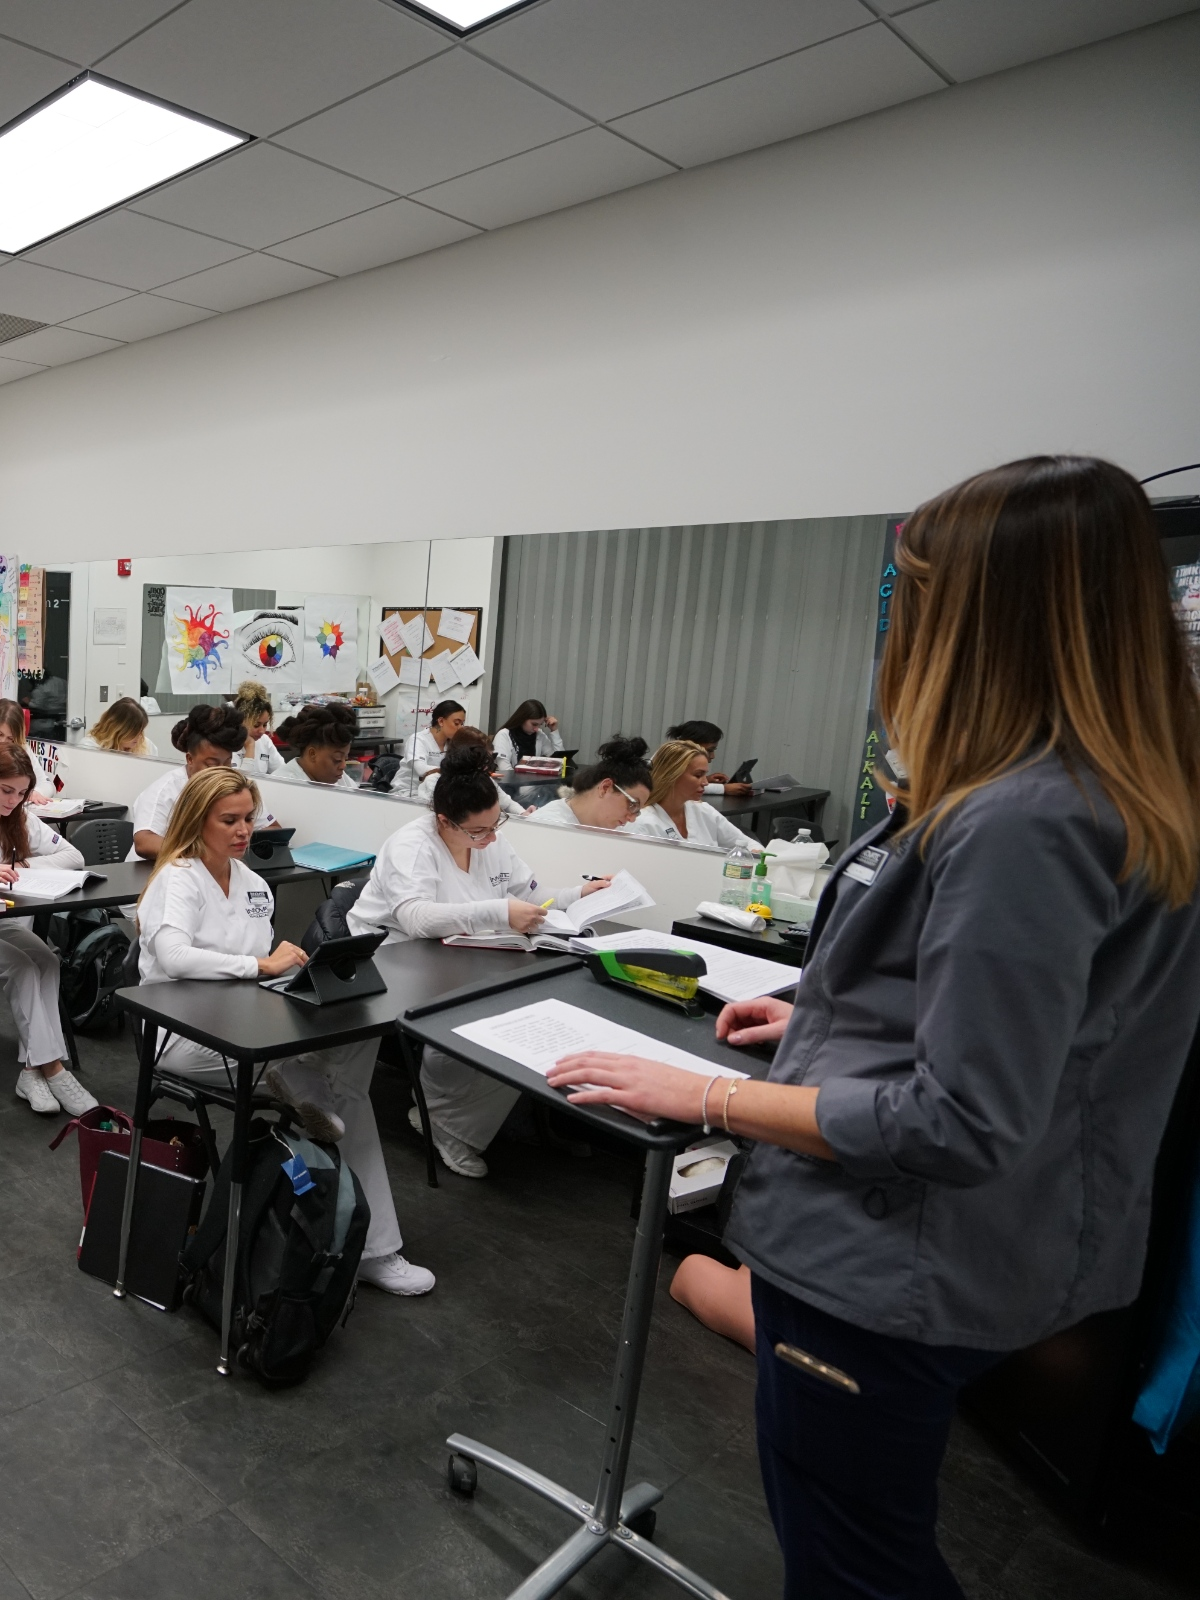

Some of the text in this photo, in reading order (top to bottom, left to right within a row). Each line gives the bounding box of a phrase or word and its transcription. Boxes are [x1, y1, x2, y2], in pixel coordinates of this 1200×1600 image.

[53, 598, 60, 609] 2
[879, 563, 897, 632] ACID
[860, 730, 879, 819] ALKALI
